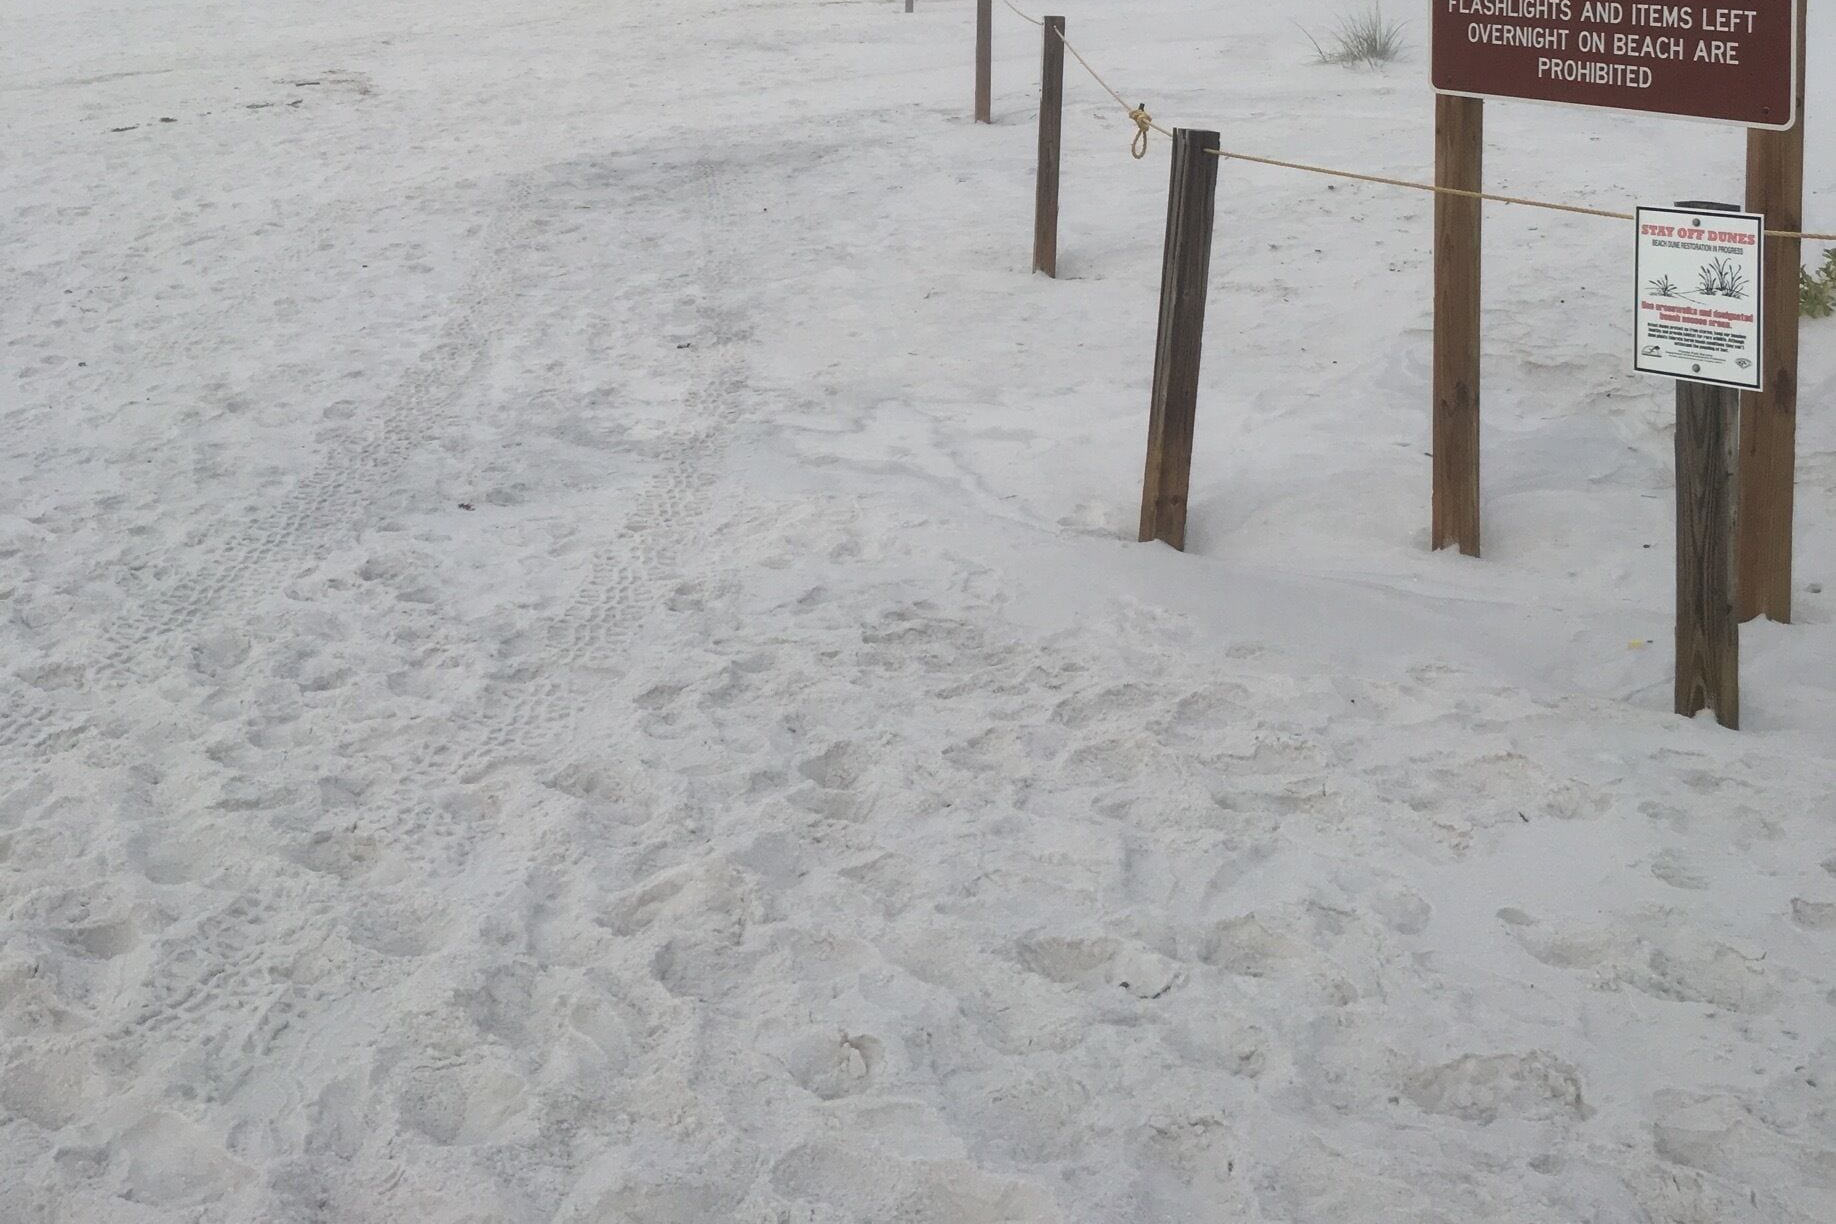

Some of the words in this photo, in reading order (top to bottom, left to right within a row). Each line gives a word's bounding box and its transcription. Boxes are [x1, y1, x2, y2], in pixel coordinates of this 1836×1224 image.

[1581, 2, 1622, 23] AND
[1632, 4, 1692, 29] ITEMS
[1702, 8, 1756, 33] LEFT
[1468, 23, 1569, 51] OVERNIGHT
[1579, 31, 1605, 53] ON
[1614, 34, 1683, 60] BEACH
[1694, 39, 1738, 64] ARE
[1539, 58, 1652, 88] PROHIBITED
[1641, 224, 1675, 237] STAY
[1677, 227, 1705, 240] OFF
[1707, 230, 1755, 245] DUNES
[1652, 239, 1667, 247] BEACH
[1668, 240, 1680, 249] DUNE
[1681, 241, 1712, 252] RESTORATION
[1718, 247, 1744, 255] PROGRESS
